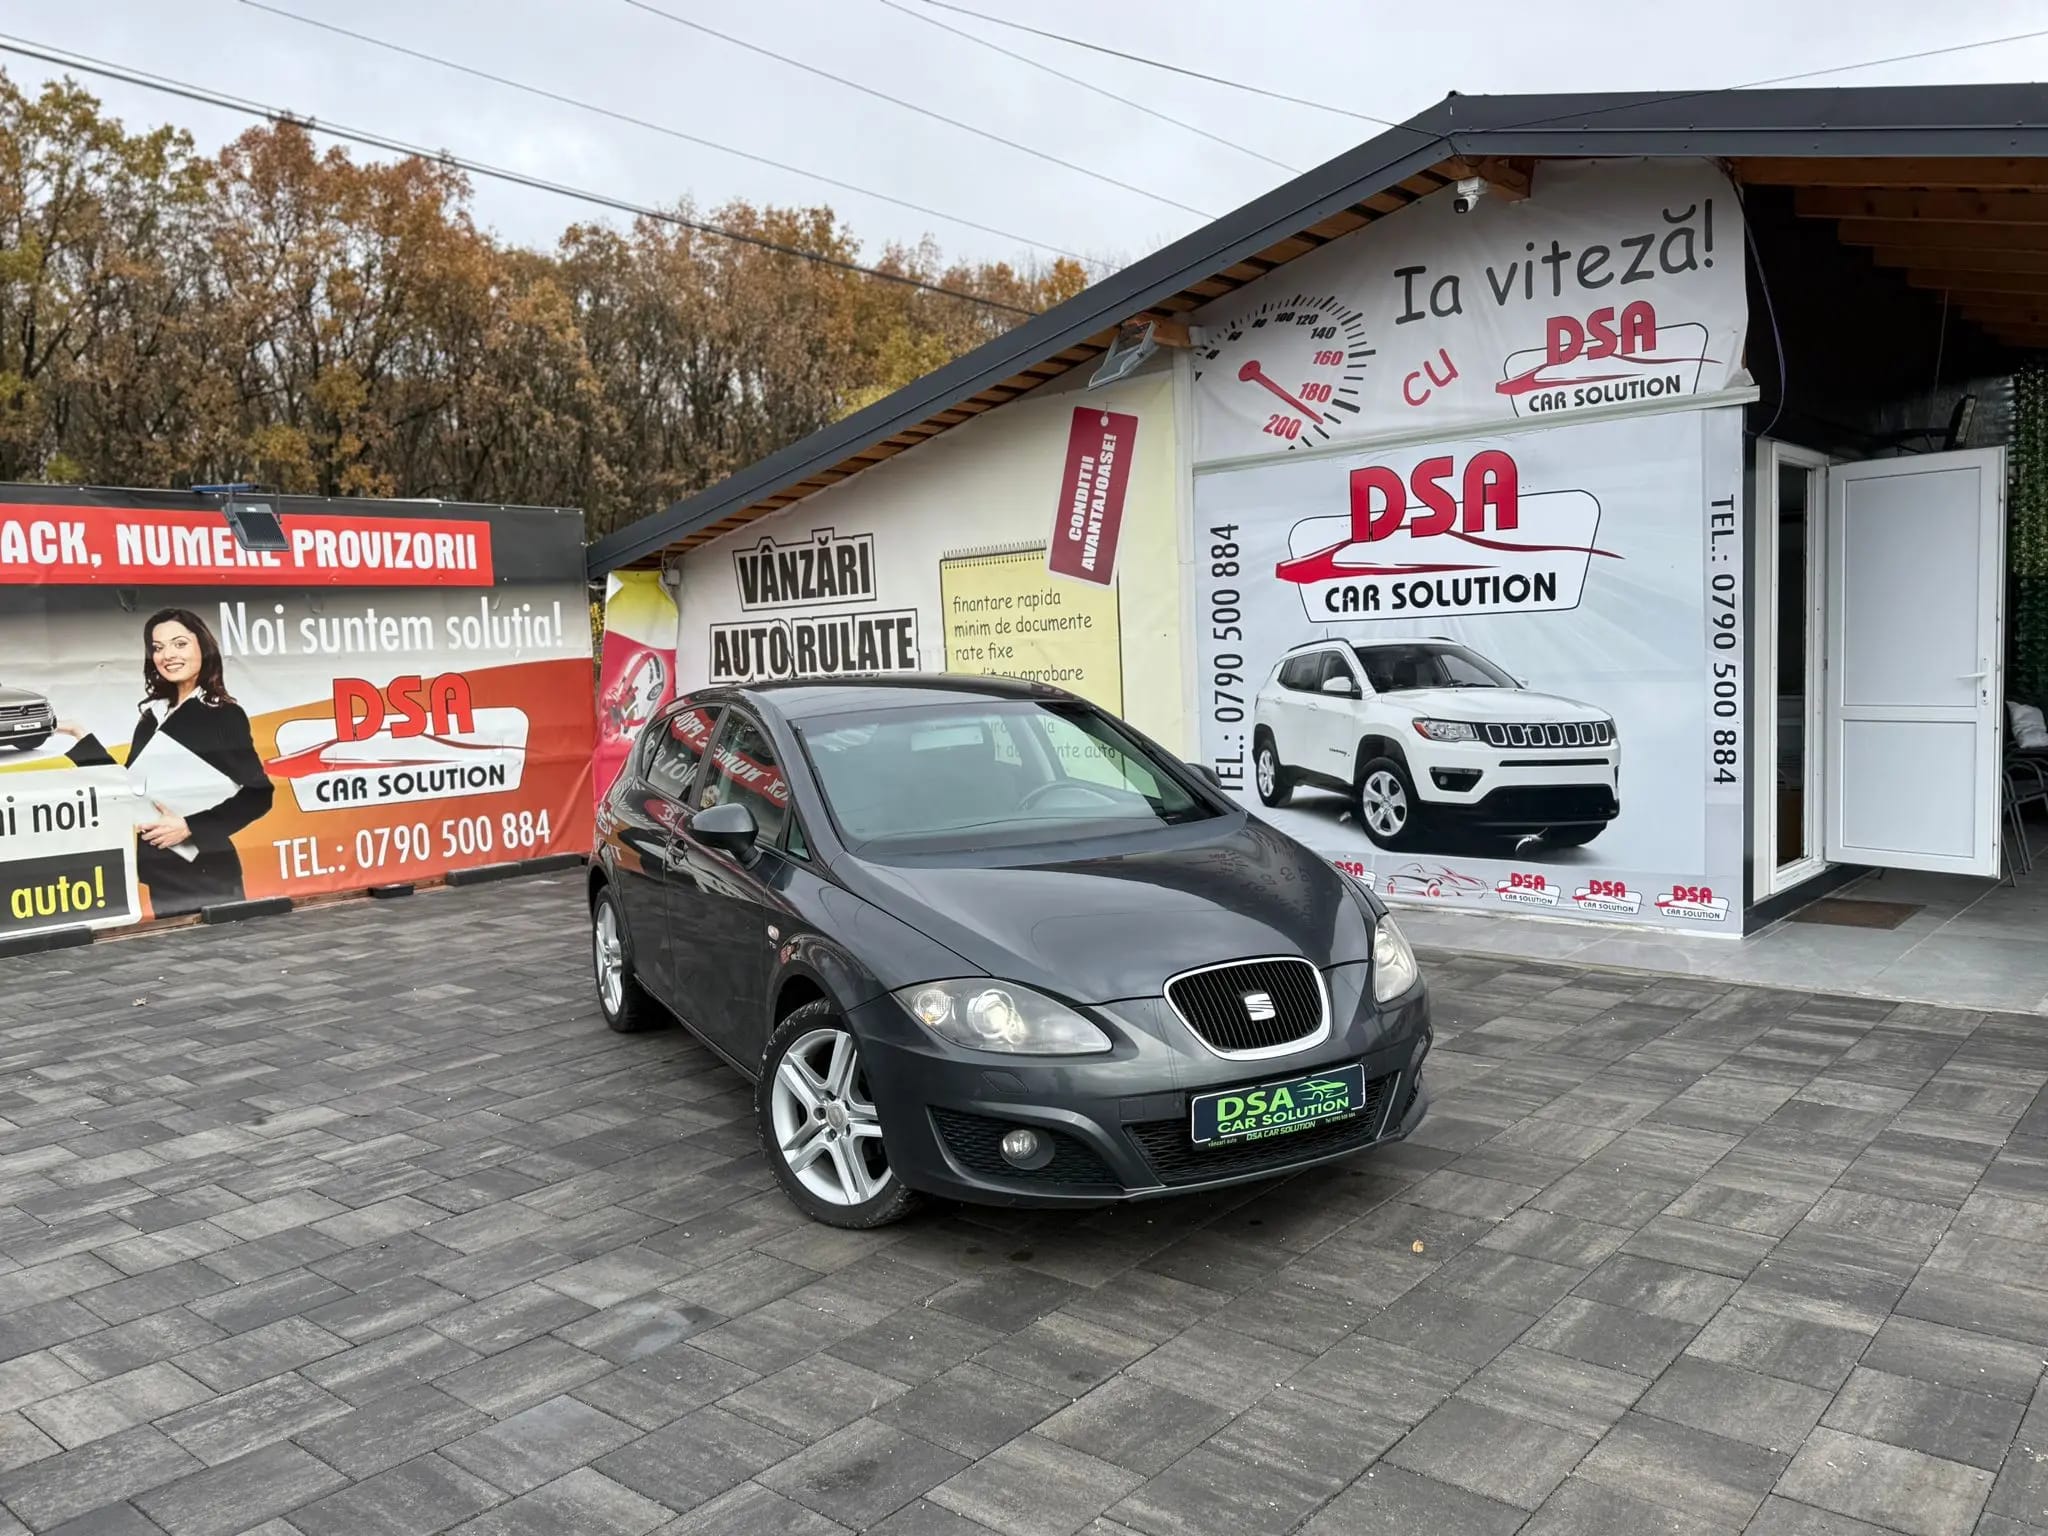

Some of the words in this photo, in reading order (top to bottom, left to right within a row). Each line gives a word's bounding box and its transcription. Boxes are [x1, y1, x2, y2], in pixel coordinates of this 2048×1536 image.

[1393, 265, 1461, 324] Ia
[1485, 198, 1715, 307] viteză!
[1274, 312, 1295, 322] 100
[1296, 314, 1319, 326] 120
[1310, 326, 1337, 339] 140
[1546, 300, 1656, 366] DSA
[1313, 350, 1344, 366] 160
[1403, 348, 1459, 406] cu
[1299, 382, 1333, 402] 180
[1528, 391, 1568, 413] CAR
[1573, 375, 1682, 408] SOLUTION
[1262, 414, 1302, 440] 200
[1068, 455, 1095, 541] CONDITII
[1081, 433, 1117, 571] AVANTAJOASE!
[1350, 450, 1518, 543] DSA
[294, 524, 478, 570] PROVIZORII
[1710, 494, 1735, 563] TEL.:
[738, 535, 871, 604] VÂNZĂRI
[1210, 524, 1240, 579] 884
[953, 595, 1013, 614] finantare
[1017, 587, 1061, 612] rapida
[1325, 583, 1379, 613] CAR
[1392, 572, 1557, 610] SOLUTION
[1711, 574, 1736, 649] 0790
[220, 602, 288, 656] Noi
[300, 608, 435, 654] suntem
[955, 620, 991, 637] minim
[995, 617, 1012, 634] de
[1016, 613, 1092, 633] documente
[1213, 593, 1242, 640] 500
[714, 626, 791, 676] AUTO
[797, 617, 915, 673] RULATE
[955, 645, 984, 660] rate
[988, 642, 1014, 660] fixe
[332, 672, 474, 743] DSA
[1215, 653, 1244, 722] 0790
[1713, 664, 1737, 717] 500
[1713, 730, 1737, 785] 884
[315, 777, 367, 803] CAR
[378, 764, 505, 797] SOLUTION
[32, 786, 99, 833] noi!
[273, 838, 346, 880] TEL.:
[356, 826, 430, 868] 0790
[442, 817, 493, 858] 500
[502, 809, 550, 849] 884
[11, 865, 106, 919] auto!
[1510, 872, 1545, 890] DSA
[1519, 895, 1553, 905] SOLUTION
[1589, 879, 1626, 898] DSA
[1673, 885, 1712, 904] DSA
[1599, 903, 1634, 913] SOLUTION
[1683, 910, 1720, 920] SOLUTION
[1217, 1087, 1294, 1122] DSA
[1217, 1117, 1256, 1133] CAR
[1262, 1096, 1349, 1125] SOLUTION
[1246, 1131, 1263, 1141] DSA
[1264, 1128, 1280, 1138] CAR
[1280, 1121, 1316, 1135] SOLUTION
